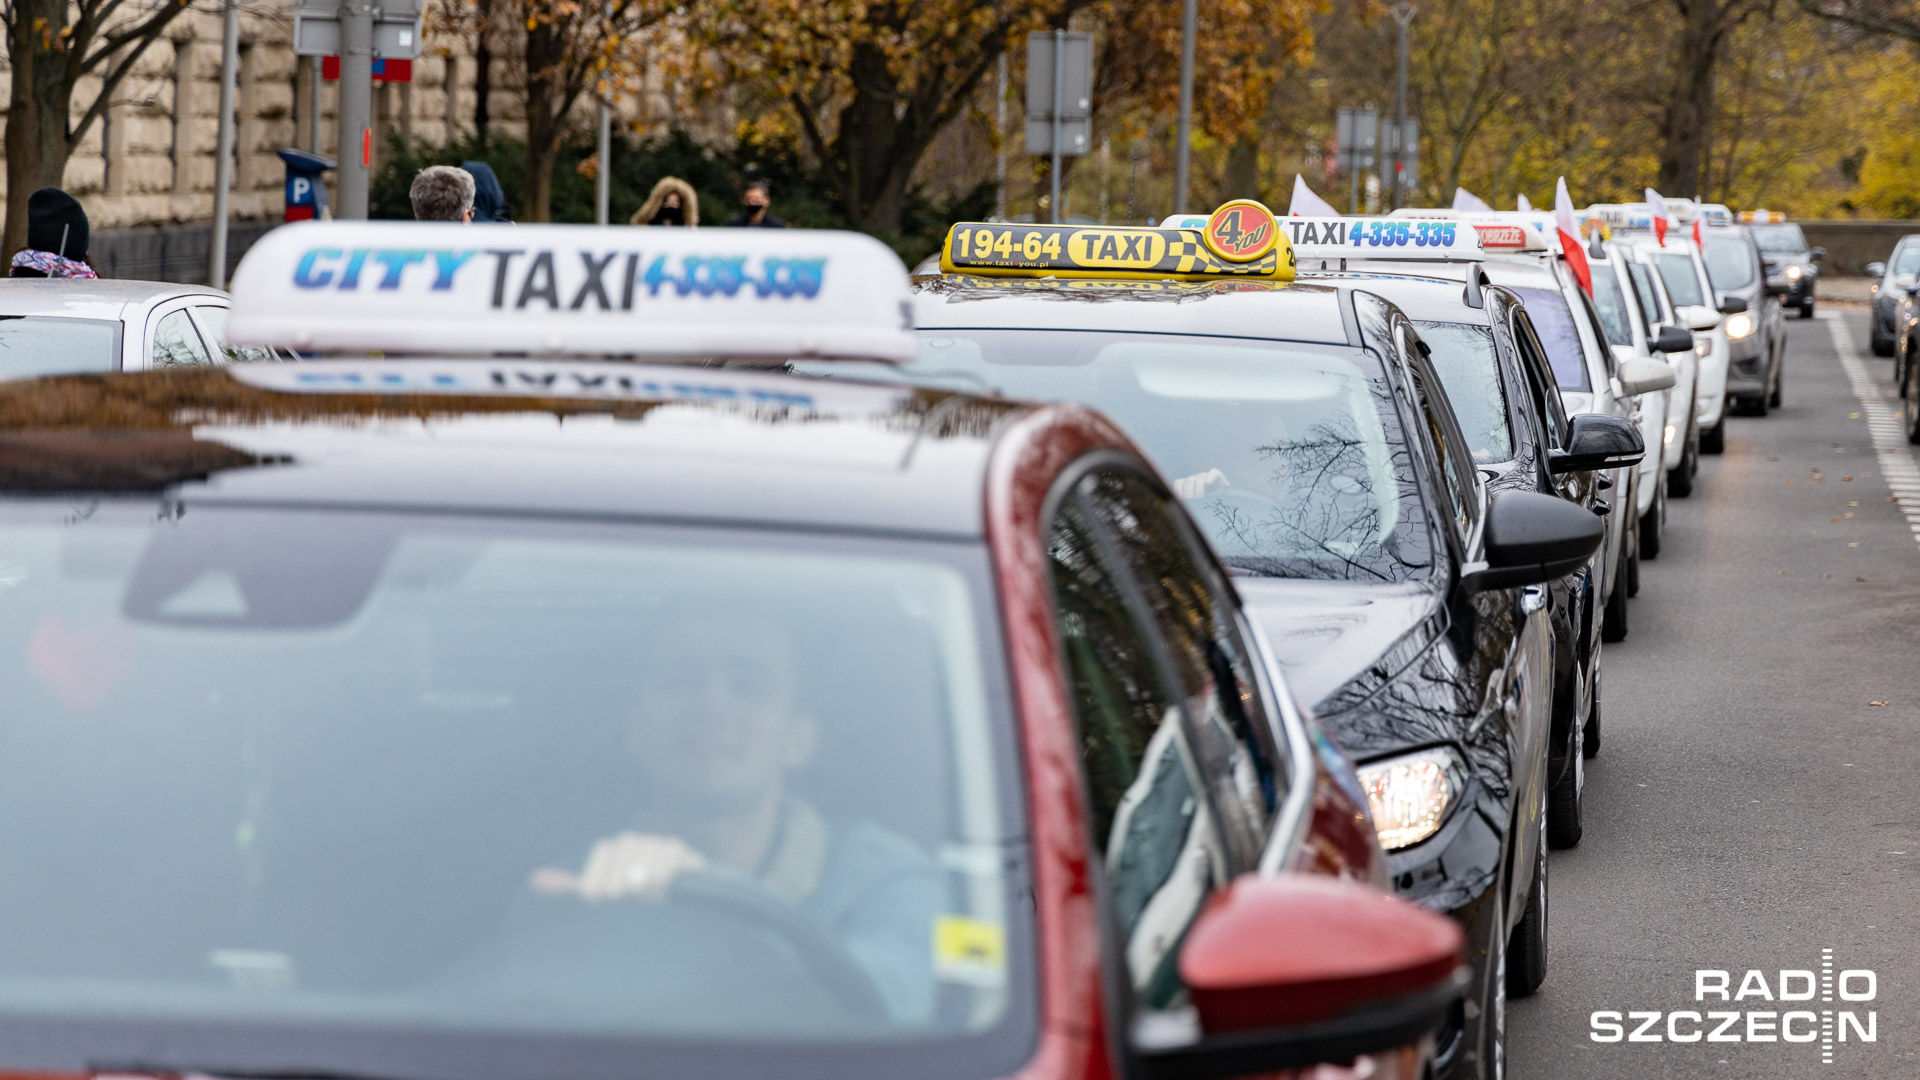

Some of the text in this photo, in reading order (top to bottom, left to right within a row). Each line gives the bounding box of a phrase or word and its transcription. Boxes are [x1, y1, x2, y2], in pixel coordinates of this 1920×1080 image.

[293, 177, 311, 202] P
[1215, 210, 1243, 245] 4
[1289, 221, 1458, 248] TAXI 4-335-335
[957, 228, 1153, 262] 194-64 TAXI
[969, 259, 1049, 268] www.taxi4you.pl
[291, 246, 477, 292] CITY
[486, 249, 641, 312] TAXI
